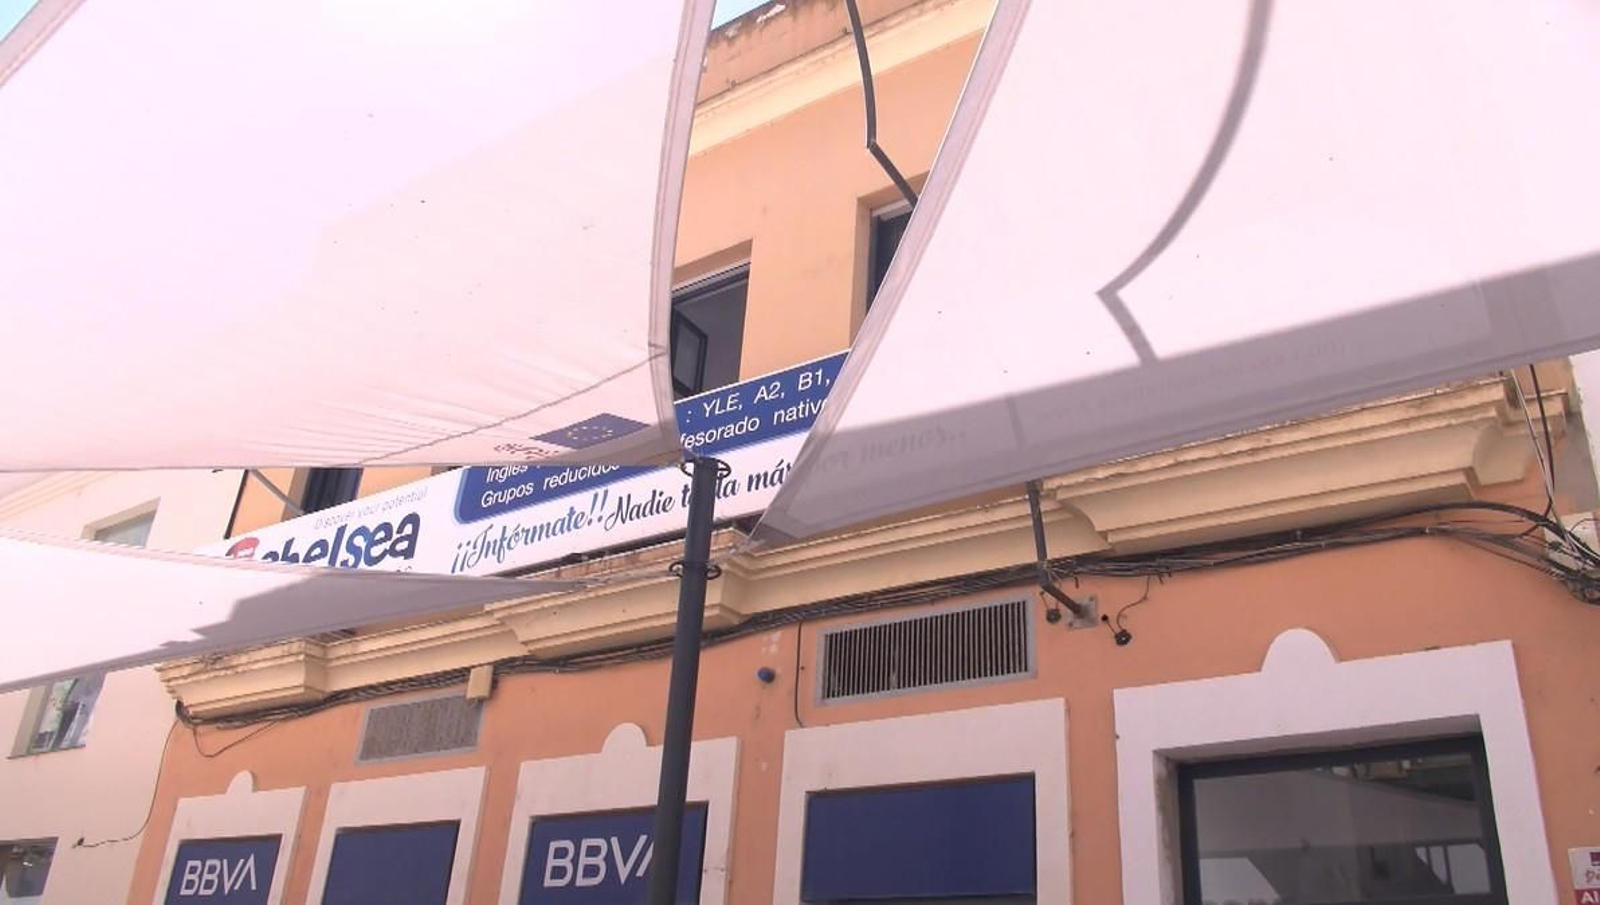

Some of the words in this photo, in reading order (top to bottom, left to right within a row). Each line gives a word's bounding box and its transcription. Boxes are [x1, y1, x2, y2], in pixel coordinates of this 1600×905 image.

[703, 392, 743, 418] YLE,
[754, 381, 785, 404] A2,
[798, 368, 830, 391] B1,
[481, 482, 535, 508] Grupos
[603, 488, 676, 532] Nadie
[179, 852, 257, 896] BBVA
